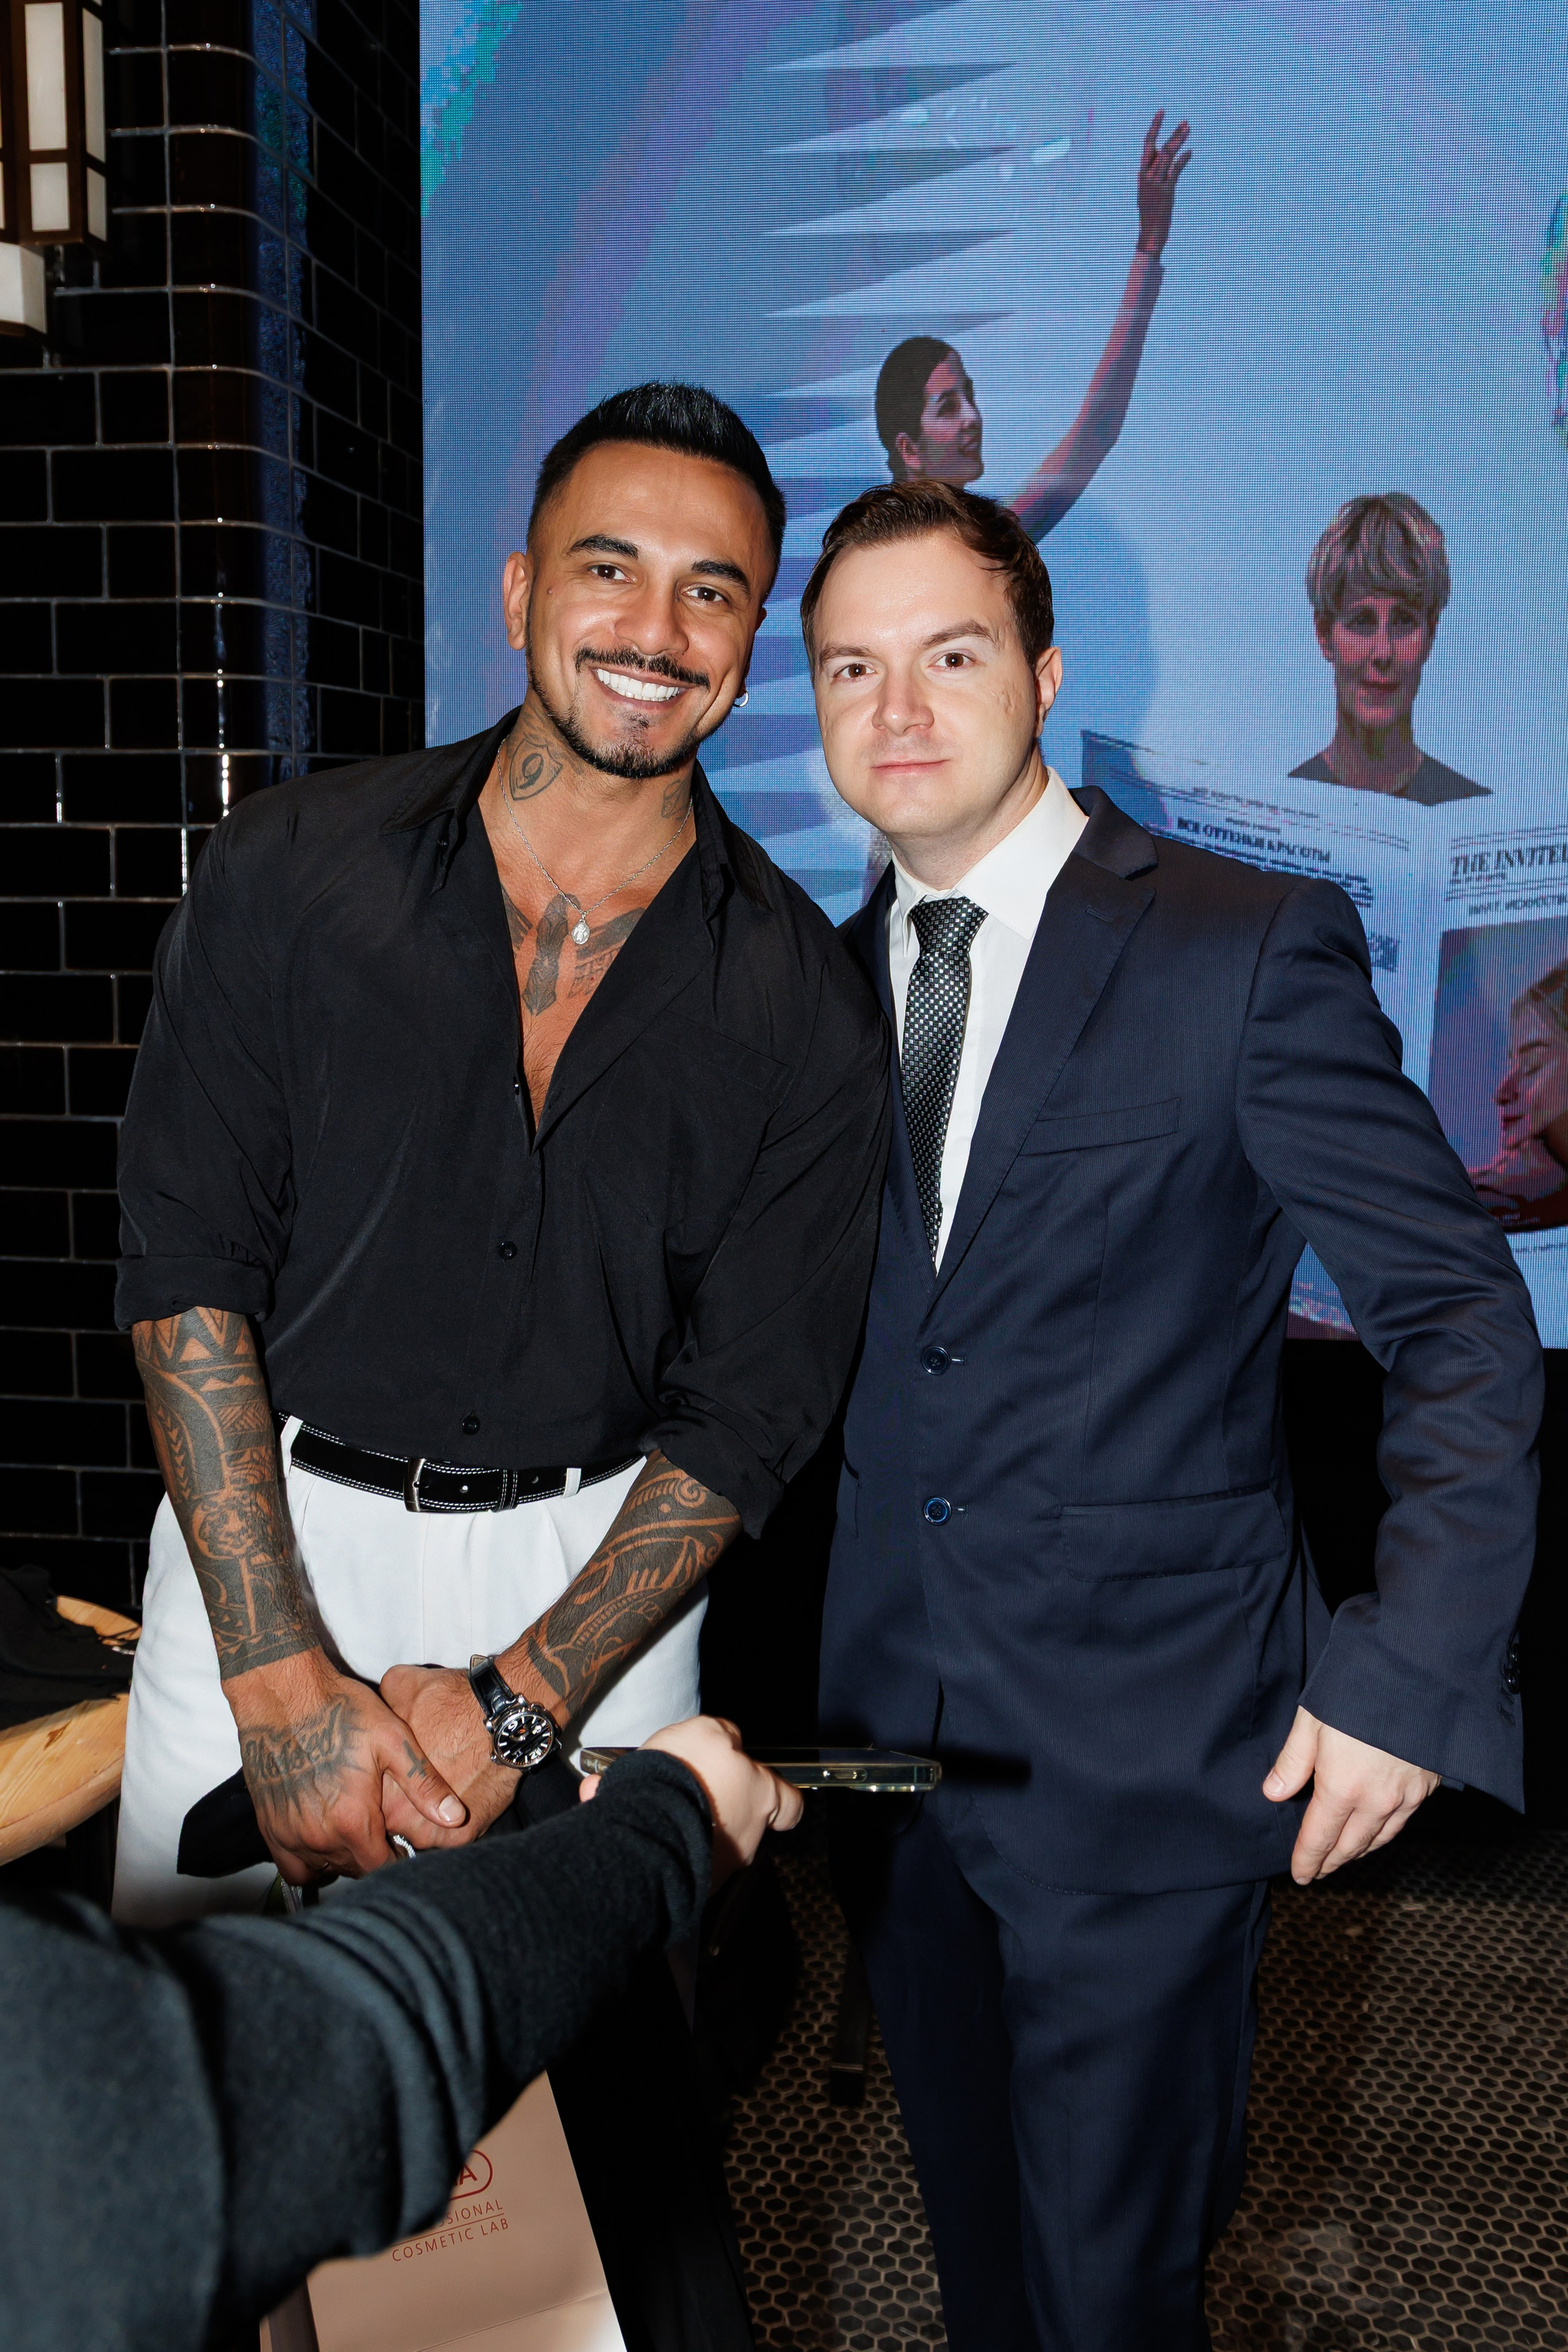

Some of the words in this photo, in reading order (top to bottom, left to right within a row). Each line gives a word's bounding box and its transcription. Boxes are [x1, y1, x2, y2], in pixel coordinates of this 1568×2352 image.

[1450, 851, 1491, 876] THE
[1494, 843, 1568, 870] INVITE
[453, 2163, 478, 2186] A
[431, 2199, 503, 2229] SIONAL
[392, 2228, 474, 2261] COSMETIC
[480, 2218, 509, 2236] LAB
